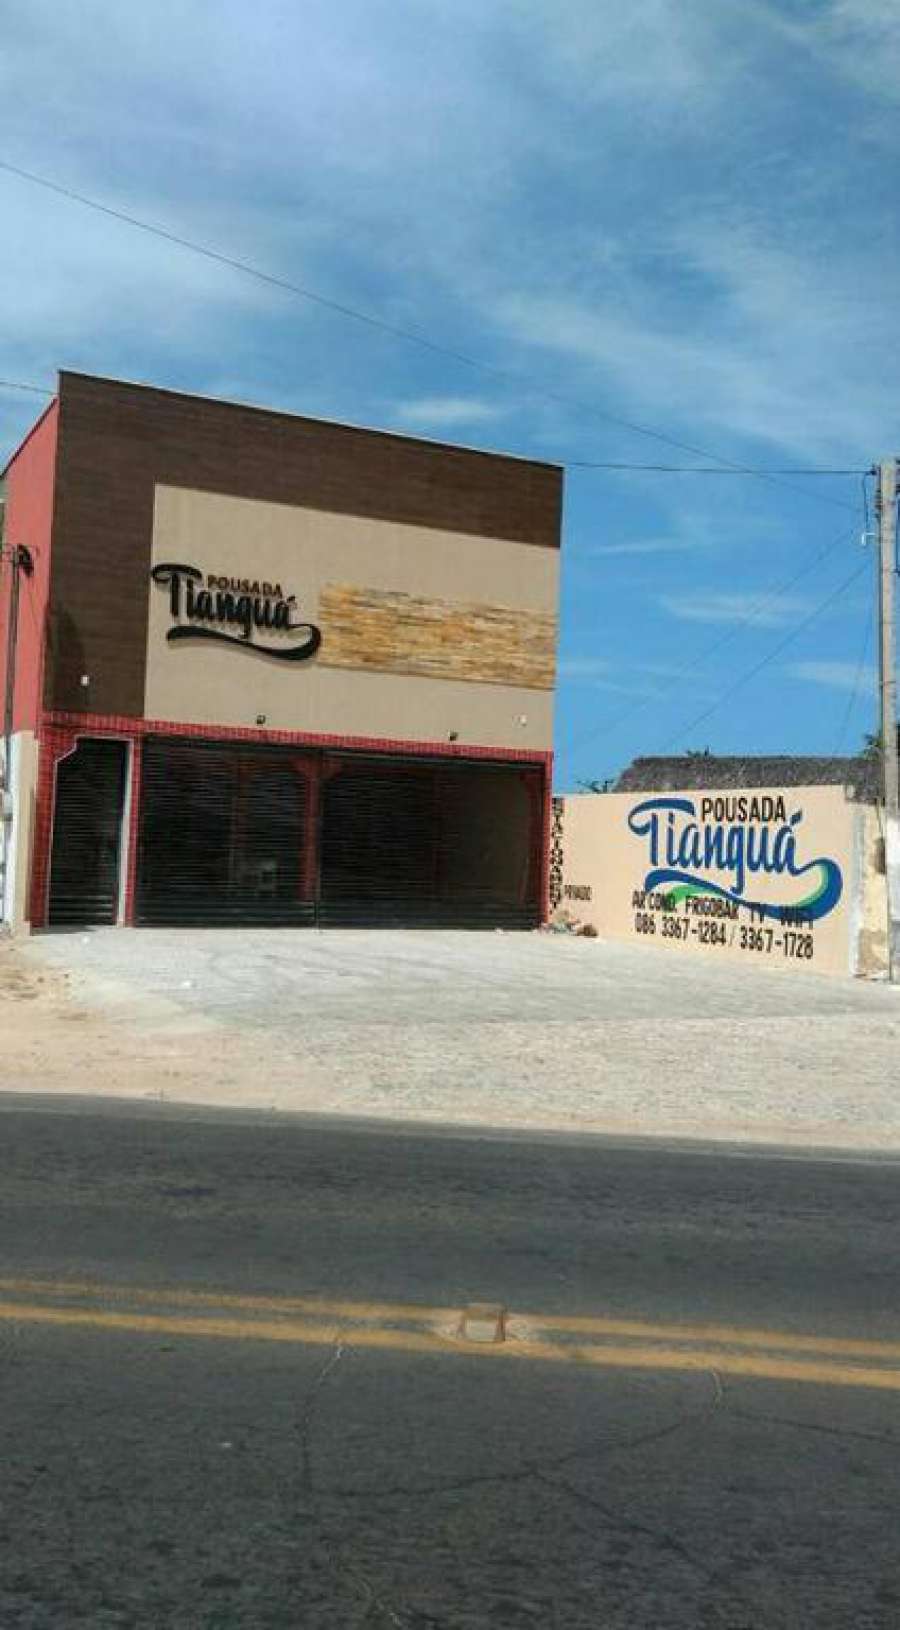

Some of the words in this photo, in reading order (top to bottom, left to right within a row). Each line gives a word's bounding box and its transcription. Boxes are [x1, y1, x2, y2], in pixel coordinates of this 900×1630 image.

[151, 563, 300, 642] Tianguá
[207, 575, 283, 598] POUSADA
[702, 795, 786, 823] POUSADA
[628, 797, 805, 896] Tianguá
[685, 895, 739, 920] FRIGOBAR
[634, 911, 657, 935] 086
[661, 915, 727, 945] 3367-1284
[740, 925, 814, 960] 3367-1728
